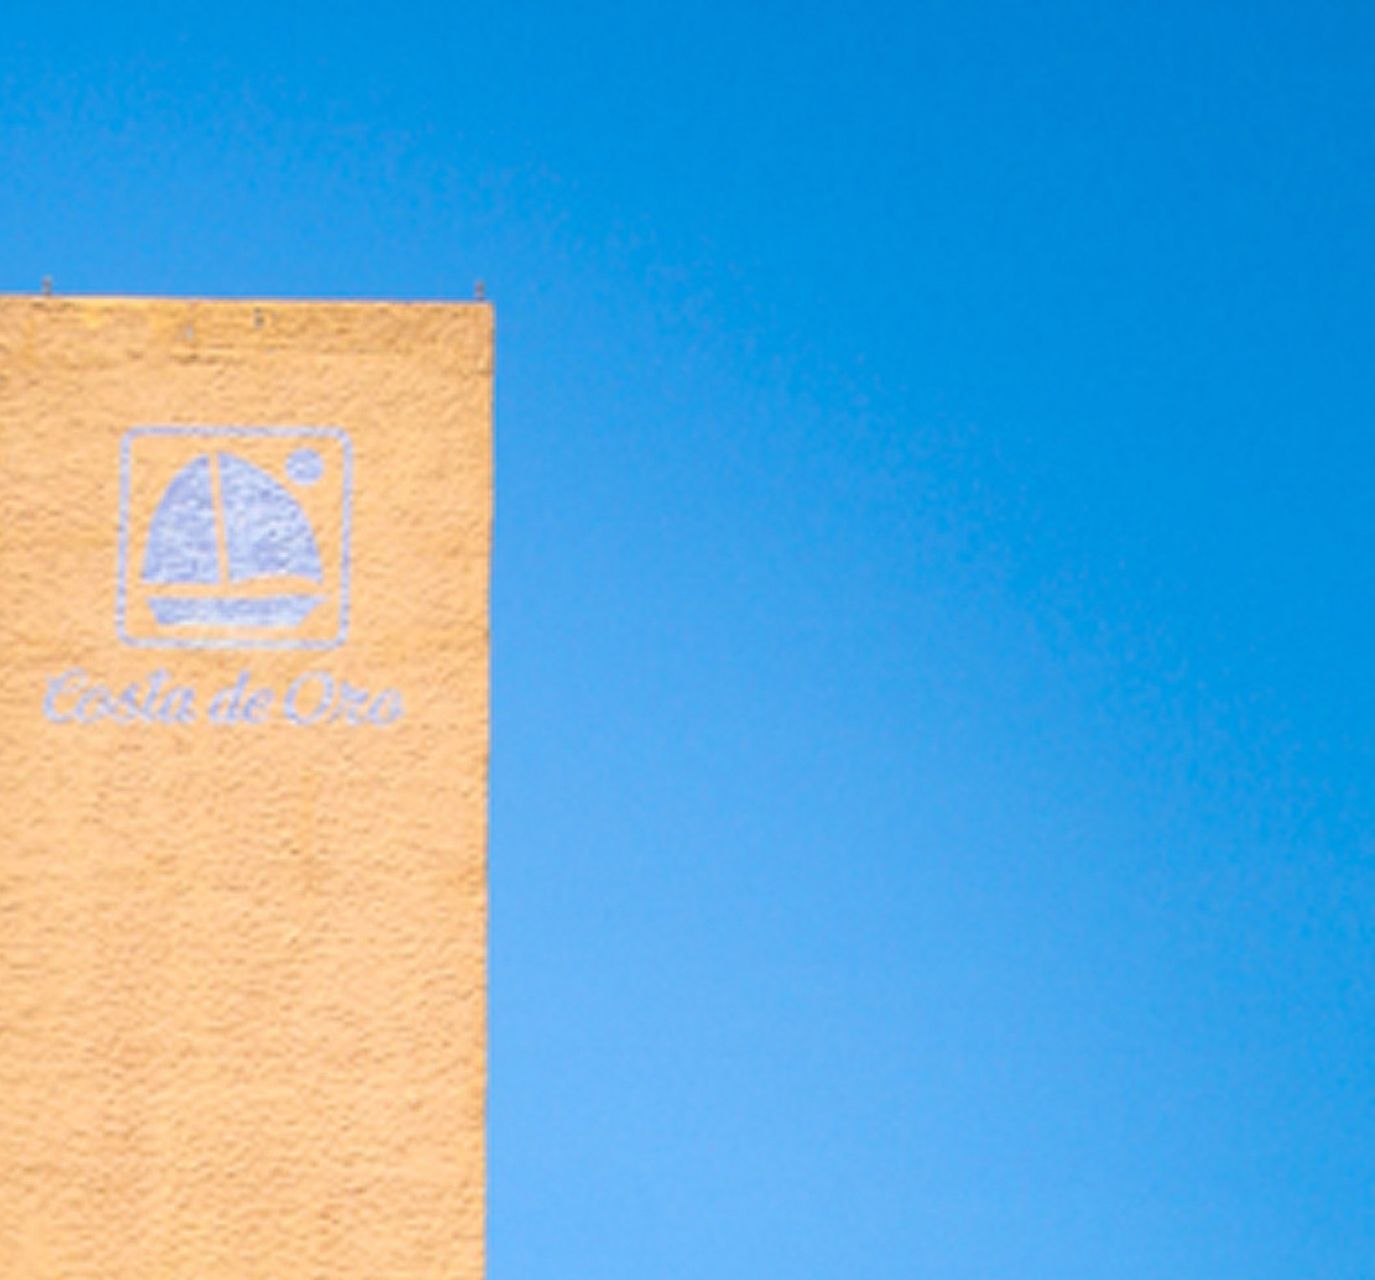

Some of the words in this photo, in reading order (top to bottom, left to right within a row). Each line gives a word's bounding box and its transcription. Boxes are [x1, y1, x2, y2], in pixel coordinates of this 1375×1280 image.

[41, 666, 197, 725] Costa
[207, 668, 275, 726] de
[282, 669, 406, 728] Oro
